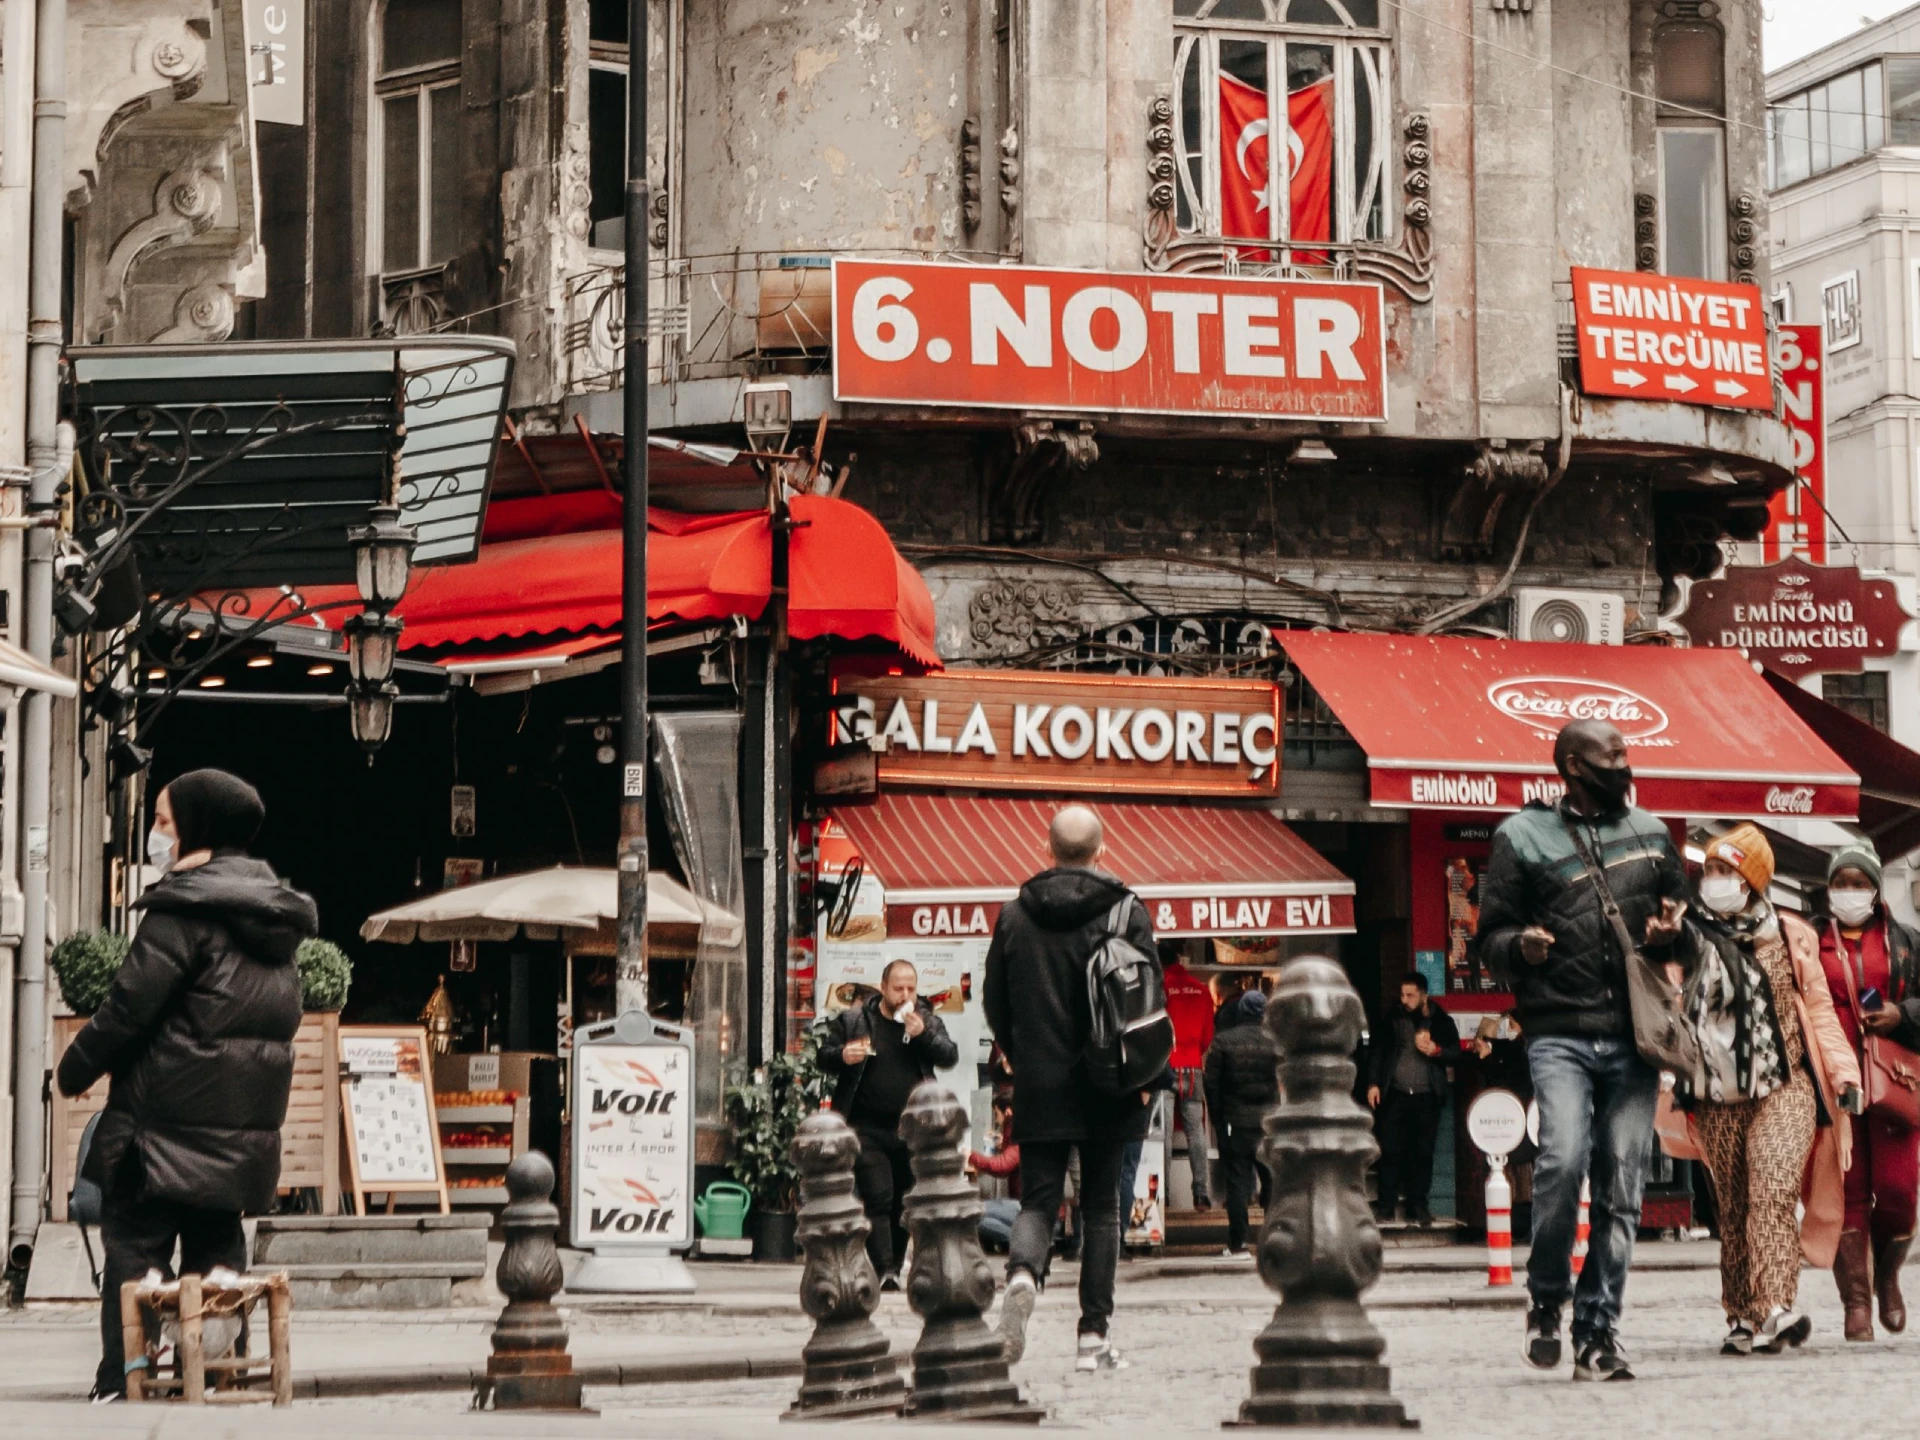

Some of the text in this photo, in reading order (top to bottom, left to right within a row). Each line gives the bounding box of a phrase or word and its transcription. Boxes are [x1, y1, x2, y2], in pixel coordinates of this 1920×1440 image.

[1588, 282, 1751, 330] EMNİYET
[1587, 325, 1765, 376] TERCÜME
[1733, 600, 1854, 622] EMİNÖNÜ
[1721, 626, 1869, 648] DÜRÜMCÜSÜ
[1498, 690, 1643, 721] Coca-Cola
[837, 696, 1277, 781] GALA KOKOREÇ
[627, 768, 640, 794] BNE
[1411, 773, 1497, 804] EMİNÖNÜ
[912, 894, 1331, 936] GALA & PİLAV EVİ
[592, 1088, 677, 1115] Voit
[590, 1207, 675, 1234] Voit
